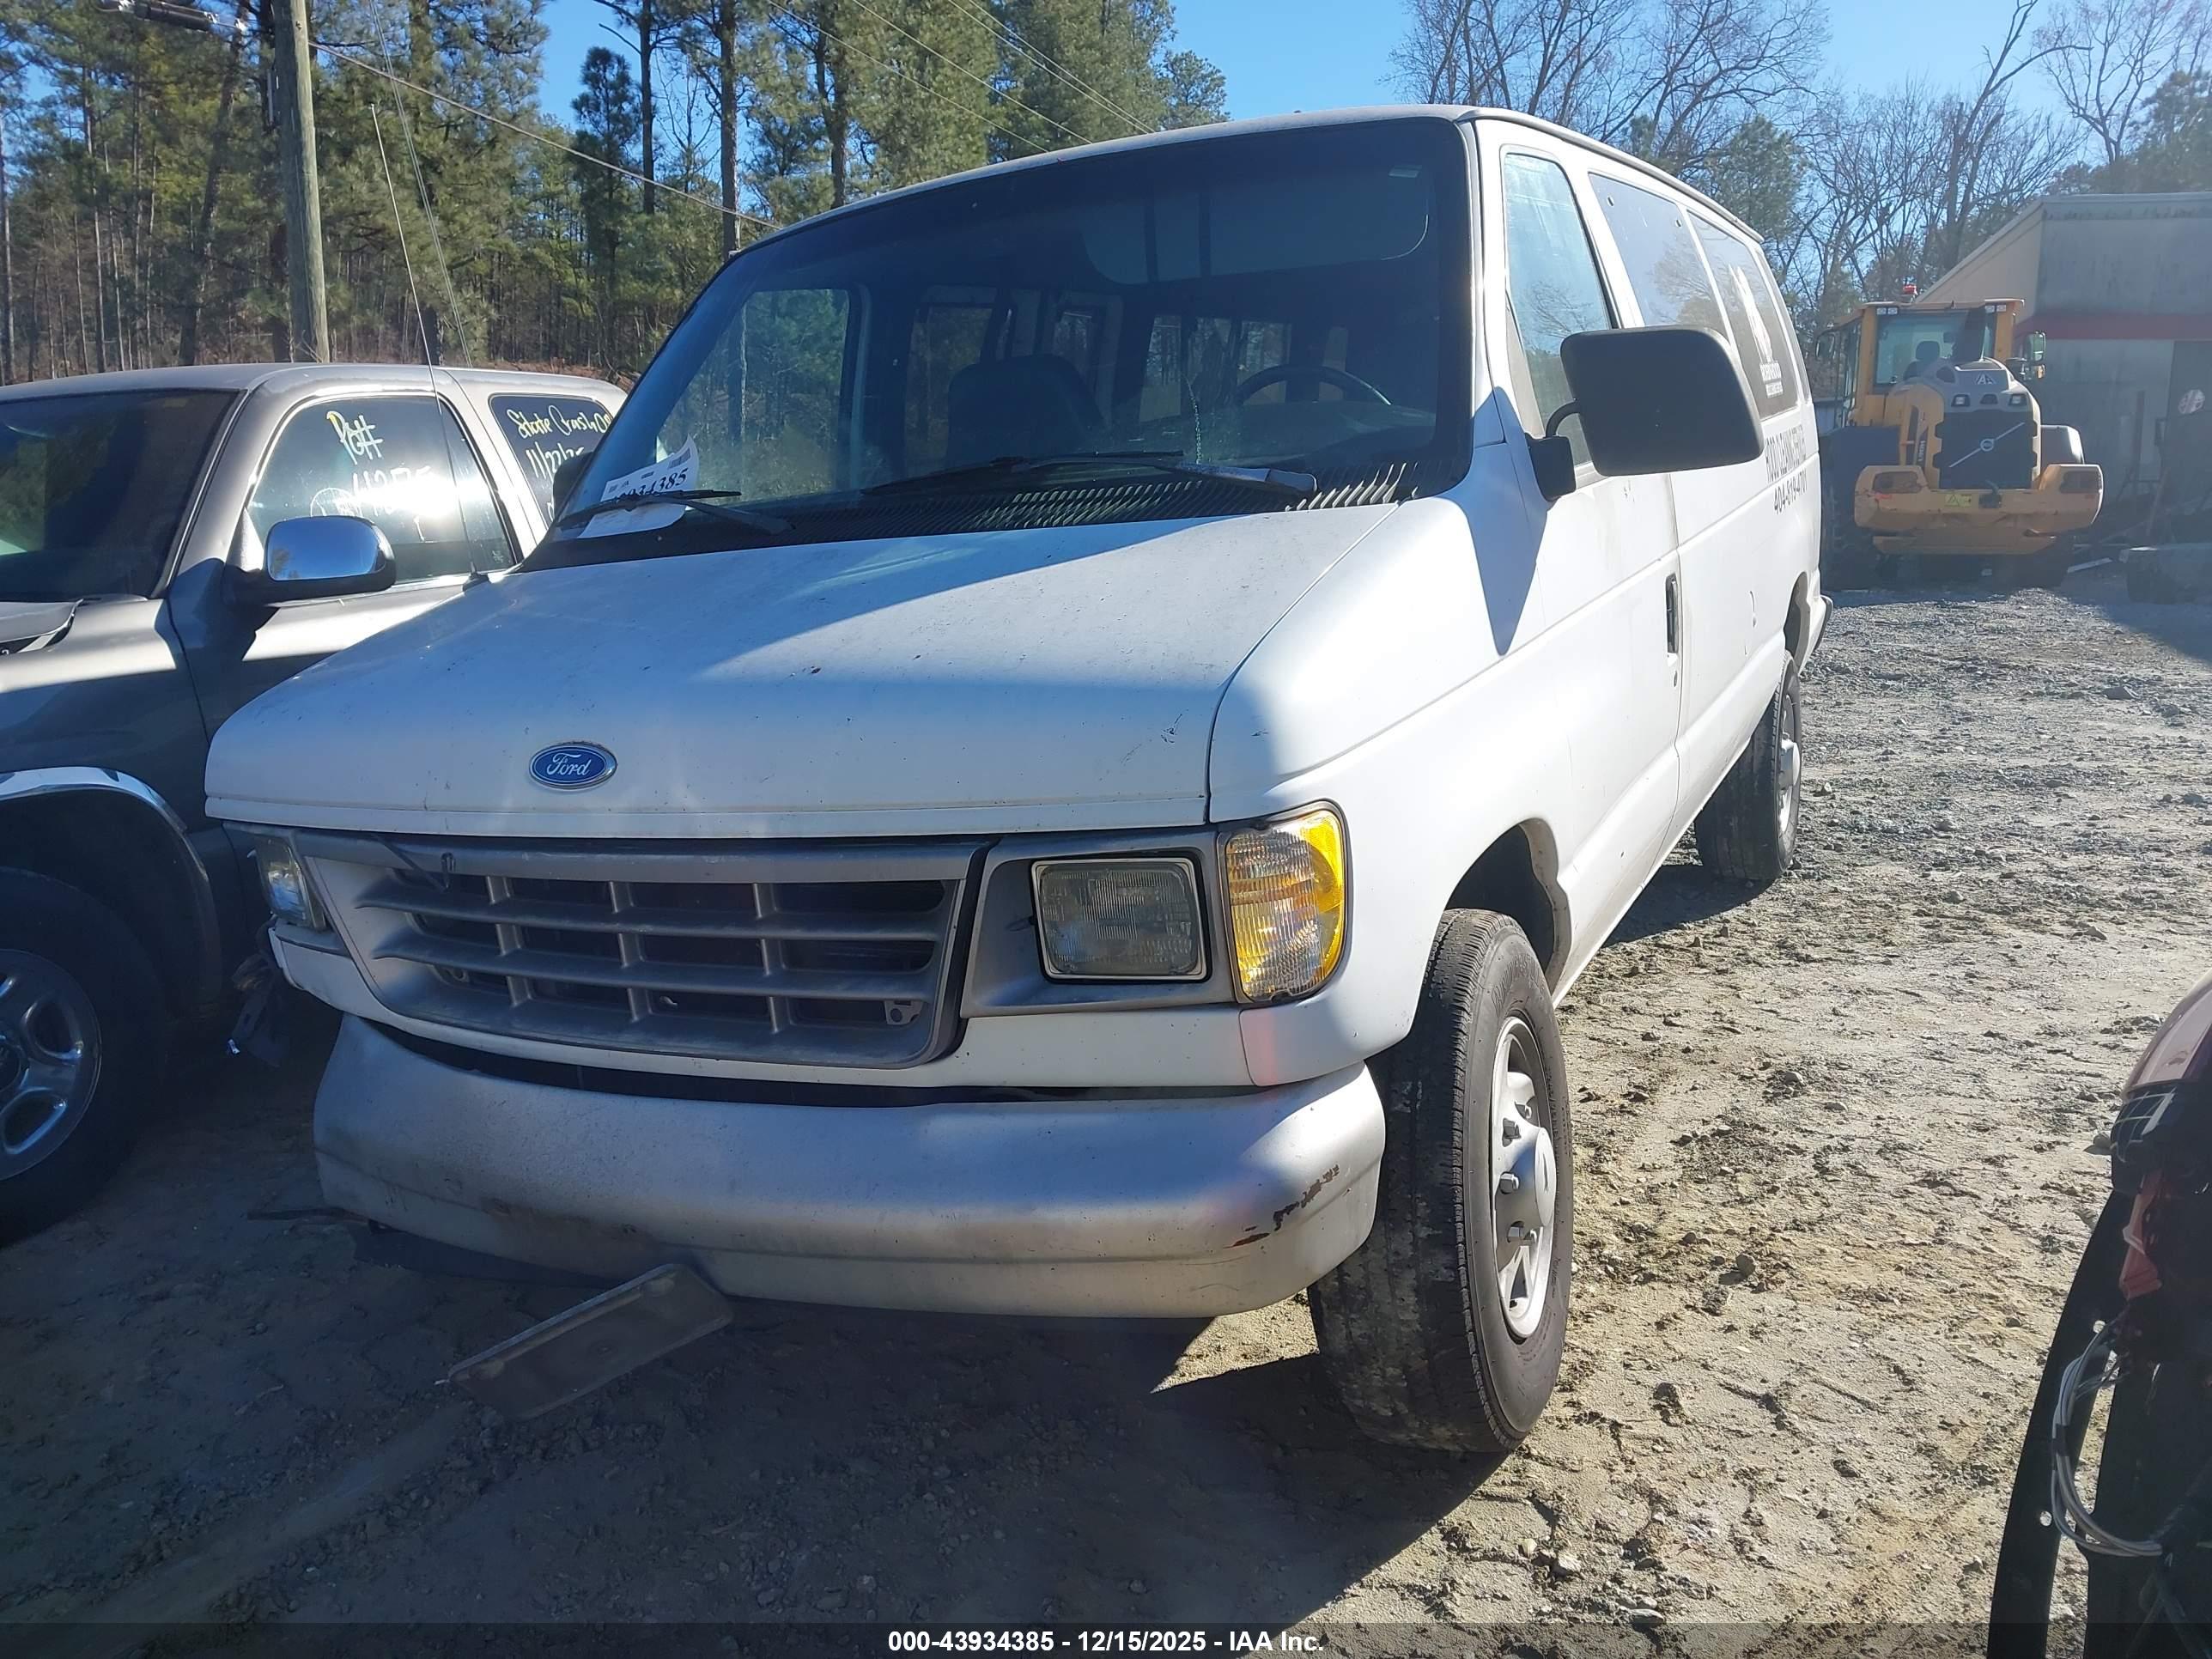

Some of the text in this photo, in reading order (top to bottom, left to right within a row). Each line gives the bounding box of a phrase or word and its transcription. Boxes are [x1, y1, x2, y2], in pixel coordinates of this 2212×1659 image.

[506, 408, 554, 440] State
[548, 404, 599, 437] Crash
[547, 753, 592, 775] Ford
